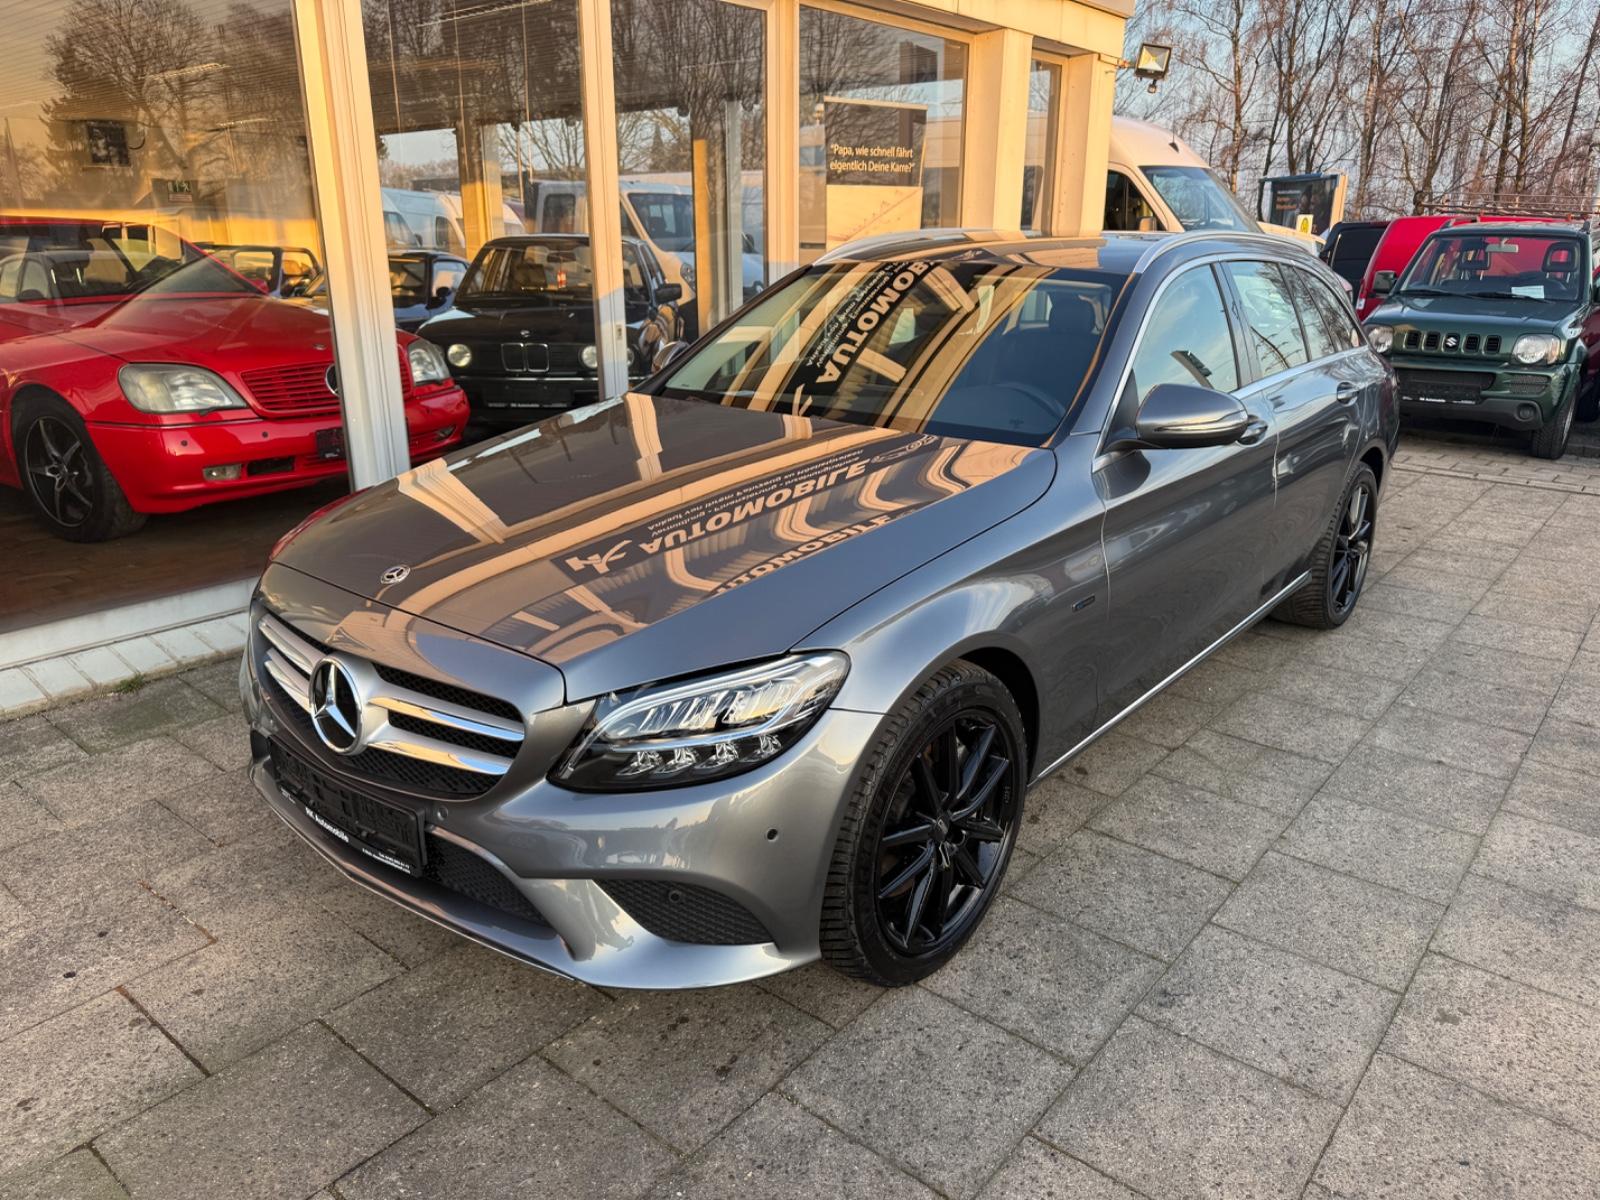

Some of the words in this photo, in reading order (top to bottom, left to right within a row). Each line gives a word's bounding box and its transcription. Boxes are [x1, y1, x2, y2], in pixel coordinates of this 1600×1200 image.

[855, 146, 869, 156] wie
[870, 146, 895, 157] schnell
[896, 147, 913, 158] fährt
[830, 160, 867, 174] eigentlich
[868, 161, 889, 173] Deine
